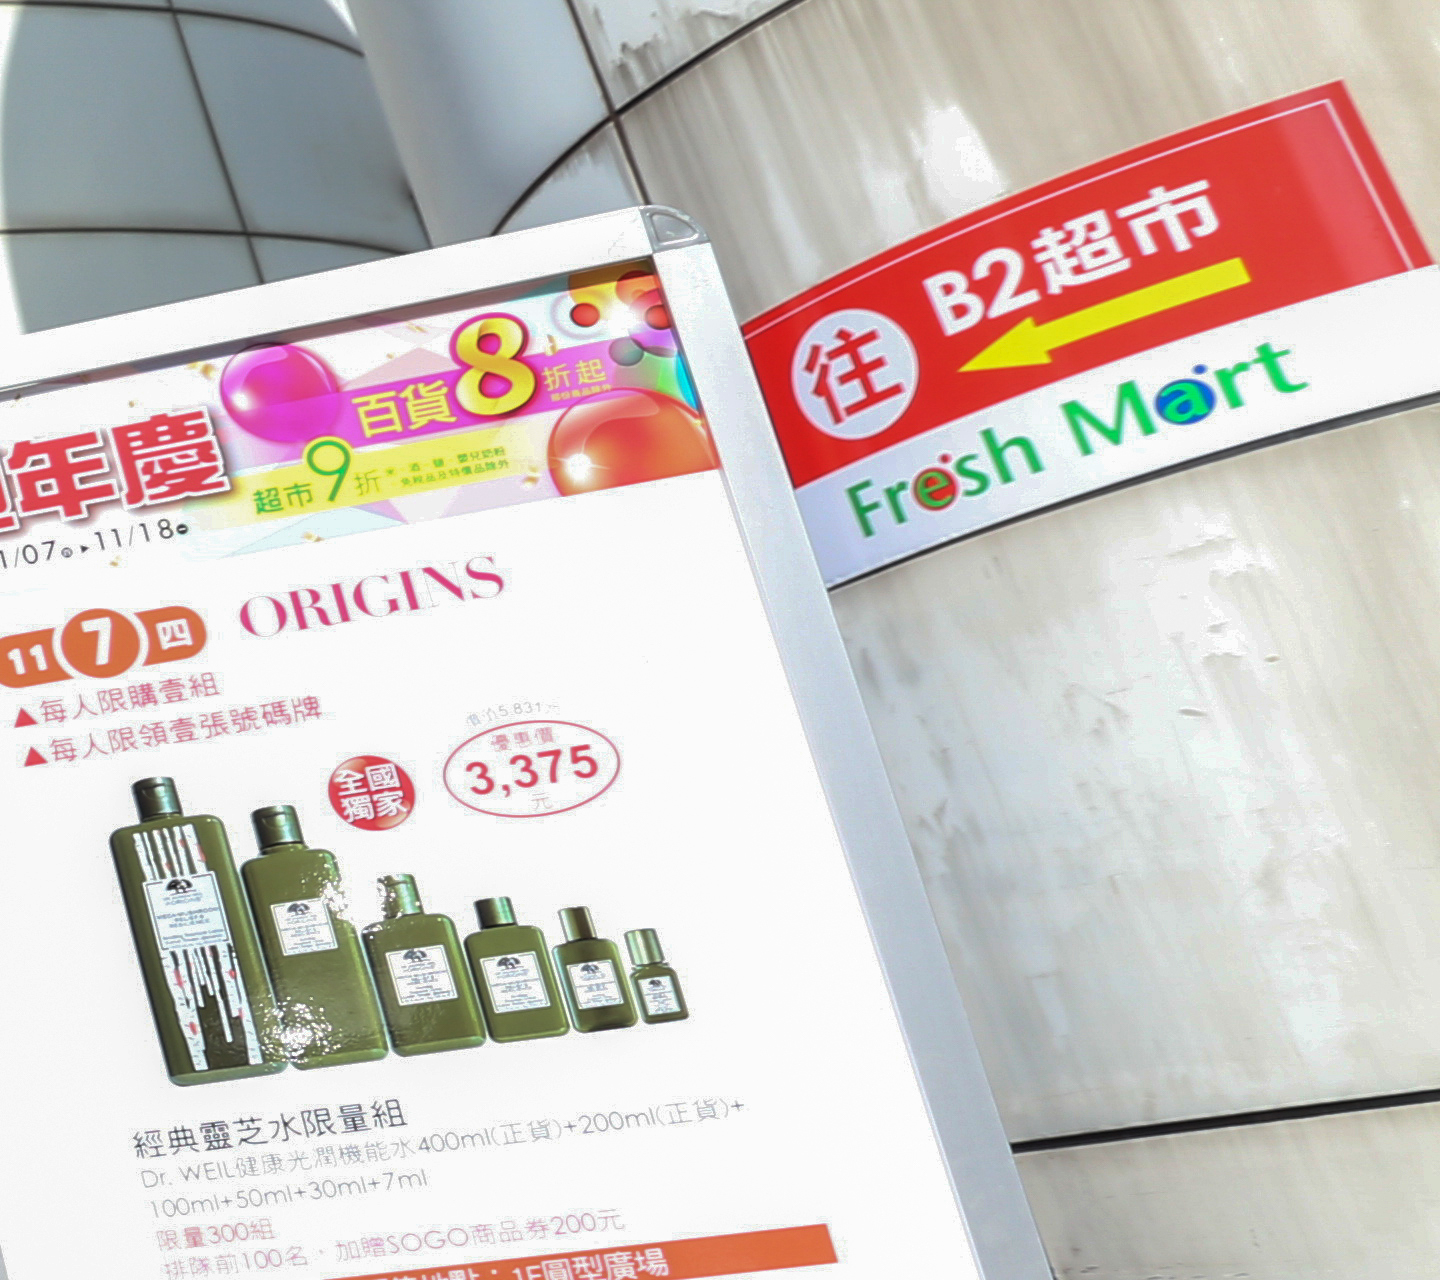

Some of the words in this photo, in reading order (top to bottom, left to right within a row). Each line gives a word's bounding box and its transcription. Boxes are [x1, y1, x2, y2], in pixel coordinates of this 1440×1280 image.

[922, 179, 1220, 336] B2超市
[803, 325, 906, 424] 往
[845, 428, 1045, 538] Fresh
[1060, 342, 1309, 457] Mart
[94, 519, 175, 549] 11/18
[240, 556, 504, 637] ORIGINS
[7, 643, 49, 675] 11
[81, 616, 113, 666] 7
[156, 618, 193, 651] 四
[334, 763, 400, 796] 全國
[465, 745, 598, 797] 3,375
[340, 791, 409, 822] 獨家
[133, 1098, 408, 1159] 經典靈芝水限量組
